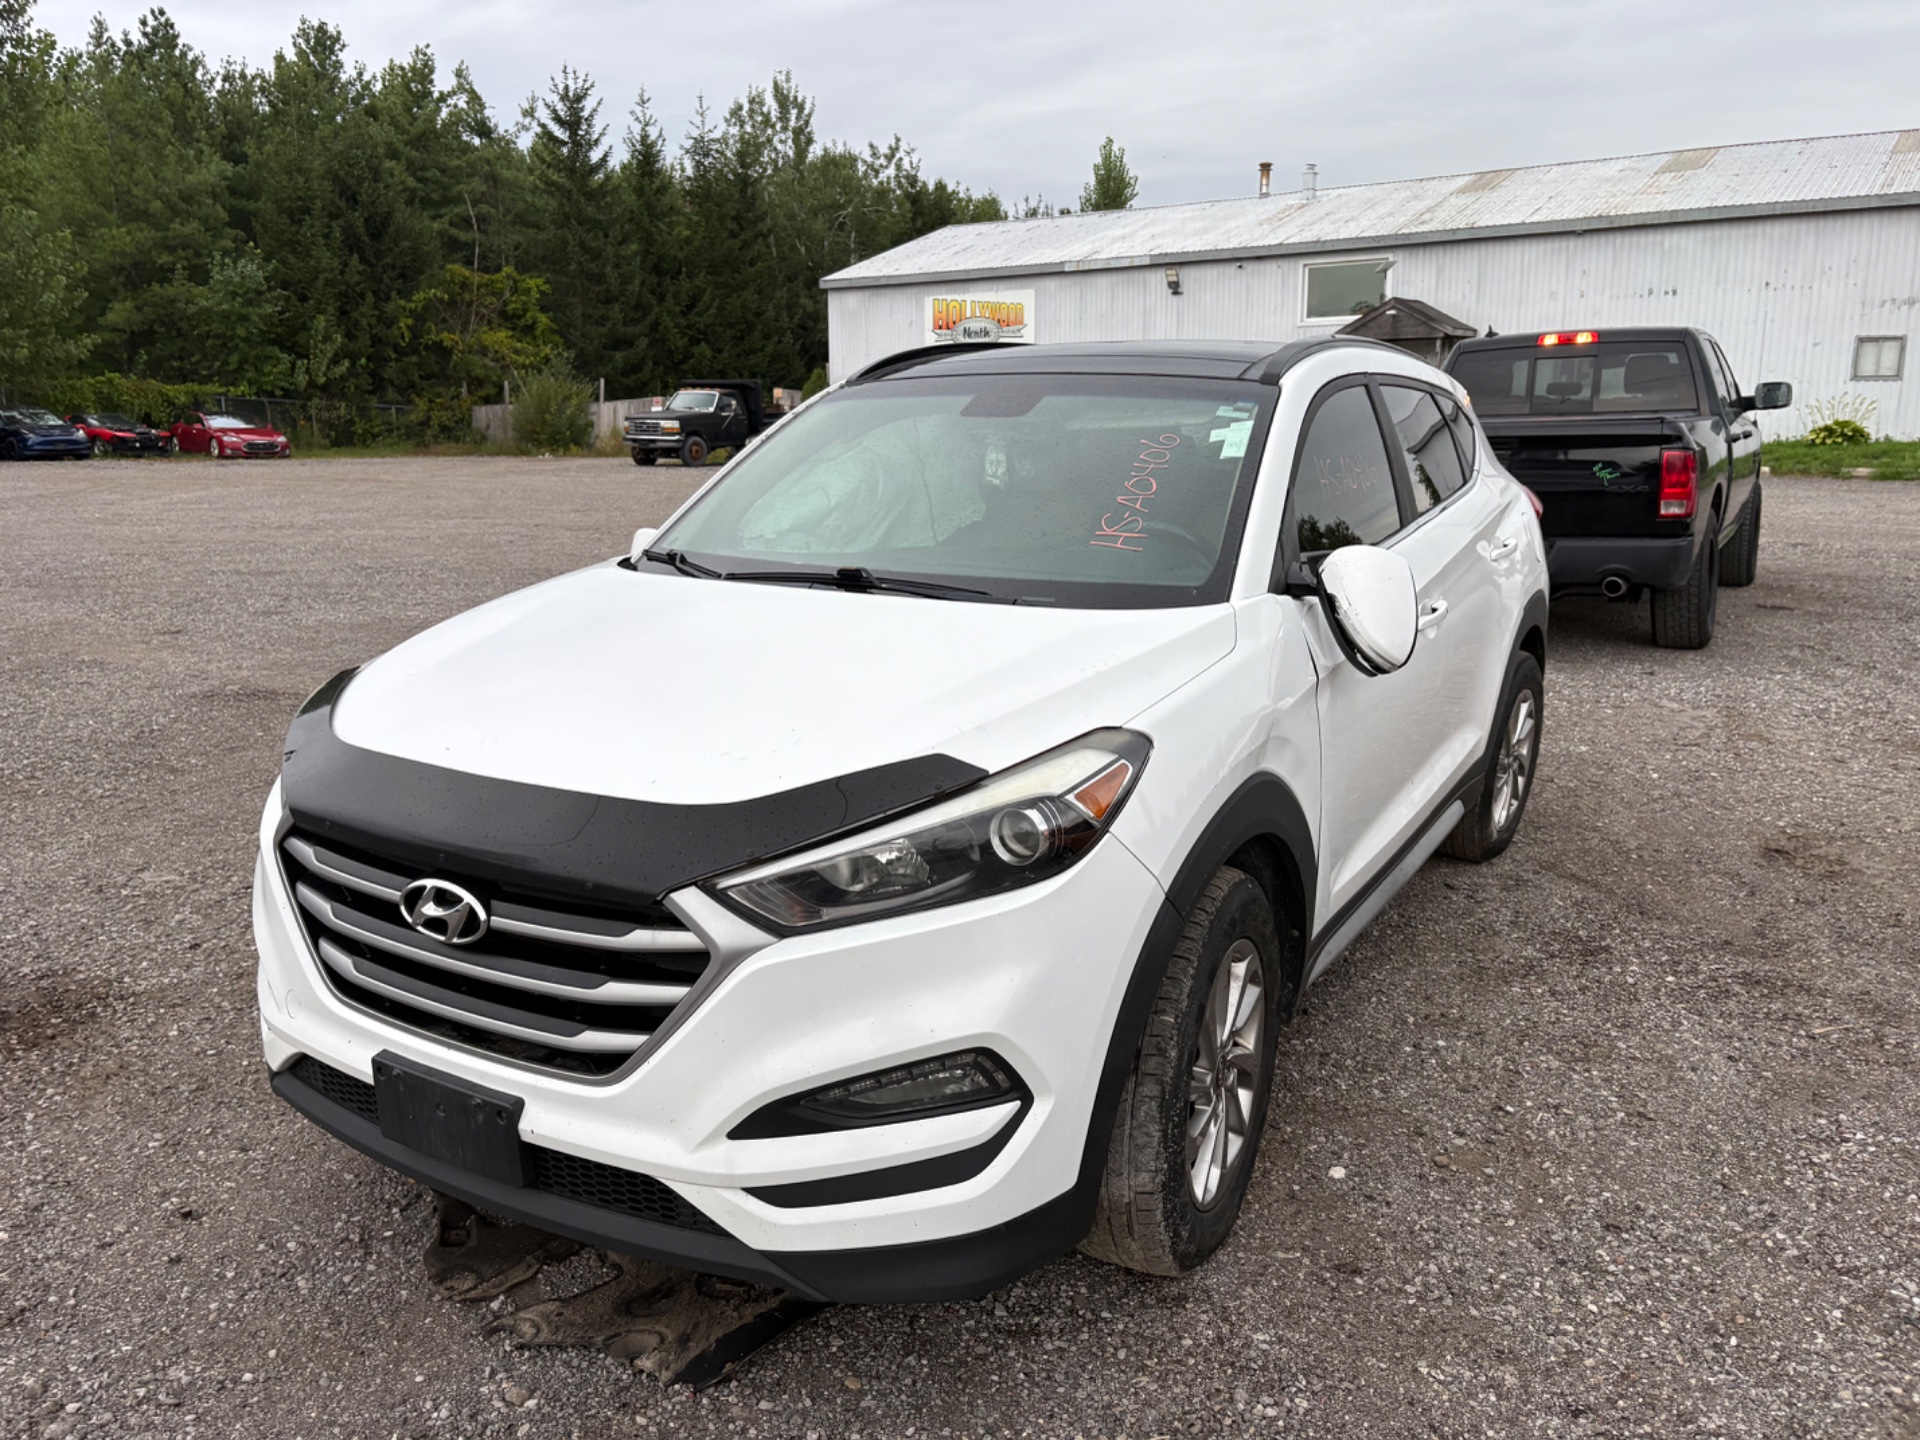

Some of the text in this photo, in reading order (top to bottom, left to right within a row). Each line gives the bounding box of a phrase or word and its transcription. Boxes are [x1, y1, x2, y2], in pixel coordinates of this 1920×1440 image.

[933, 298, 1025, 330] HOLLYWOOD
[963, 326, 991, 339] North
[1089, 433, 1180, 551] HS-A0406
